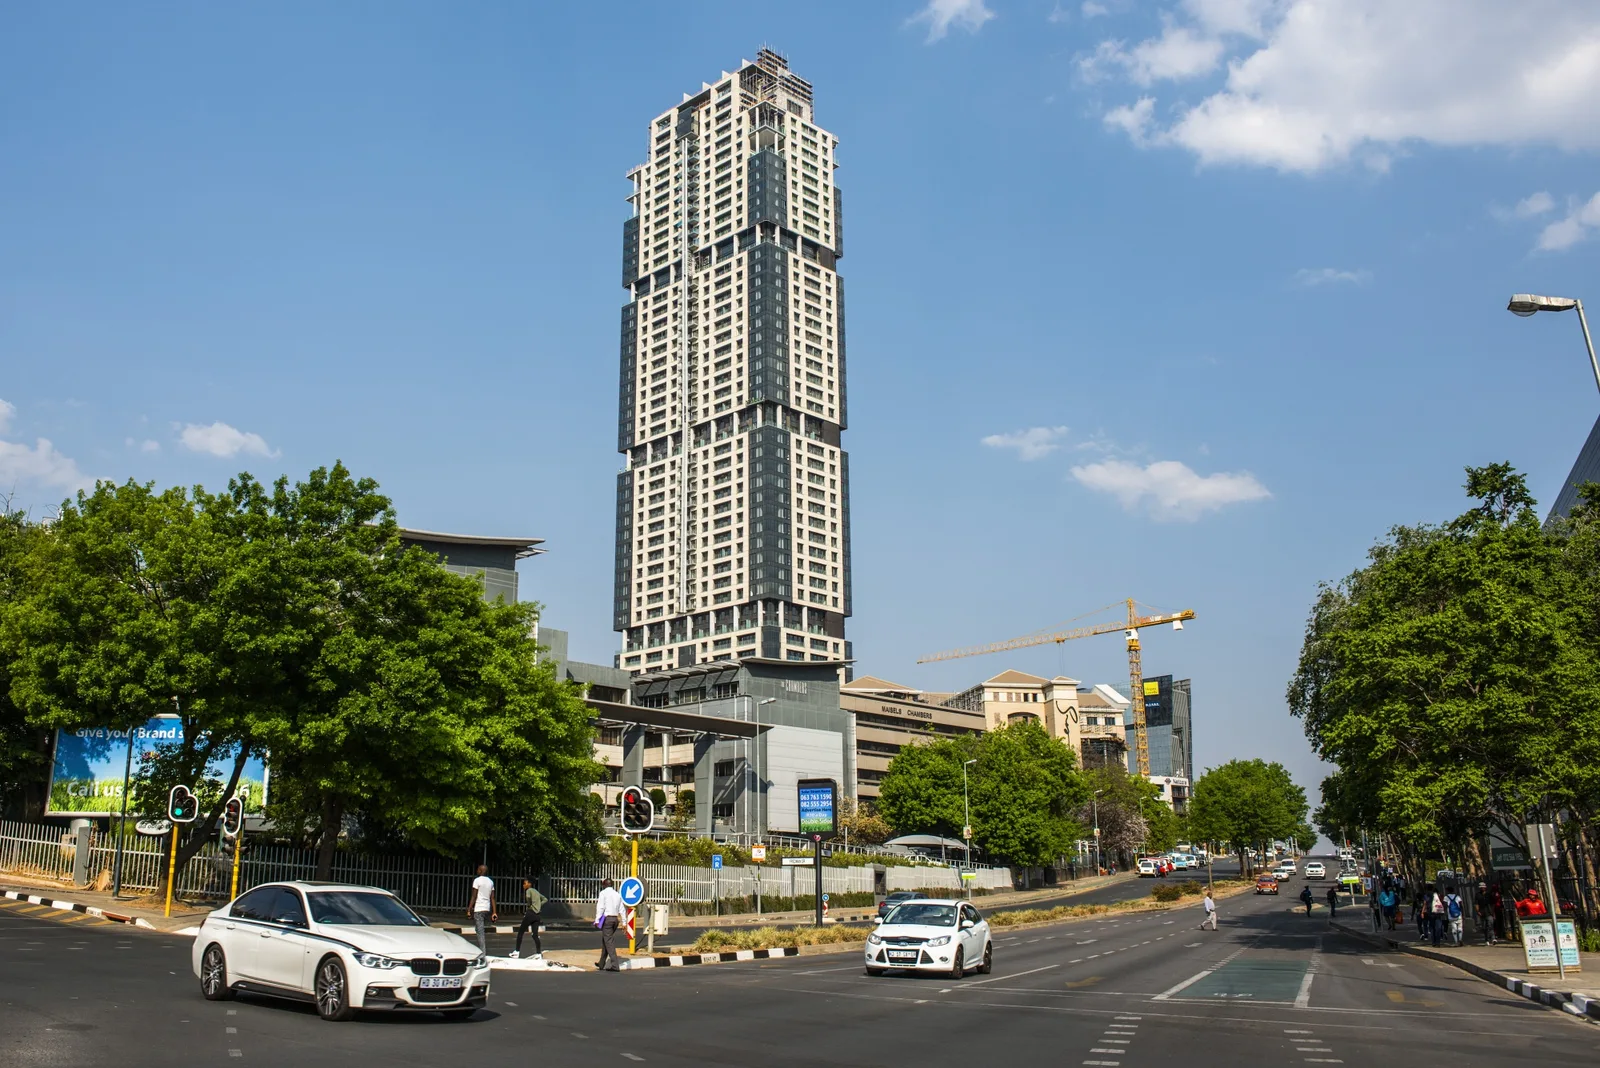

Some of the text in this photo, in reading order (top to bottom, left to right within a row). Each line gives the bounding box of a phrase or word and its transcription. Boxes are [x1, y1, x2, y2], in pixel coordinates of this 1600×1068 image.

[881, 706, 932, 719] MAISELS CHAMBERS
[76, 728, 103, 738] Give
[138, 727, 176, 738] Brand
[67, 782, 98, 796] Call
[104, 785, 124, 796] us
